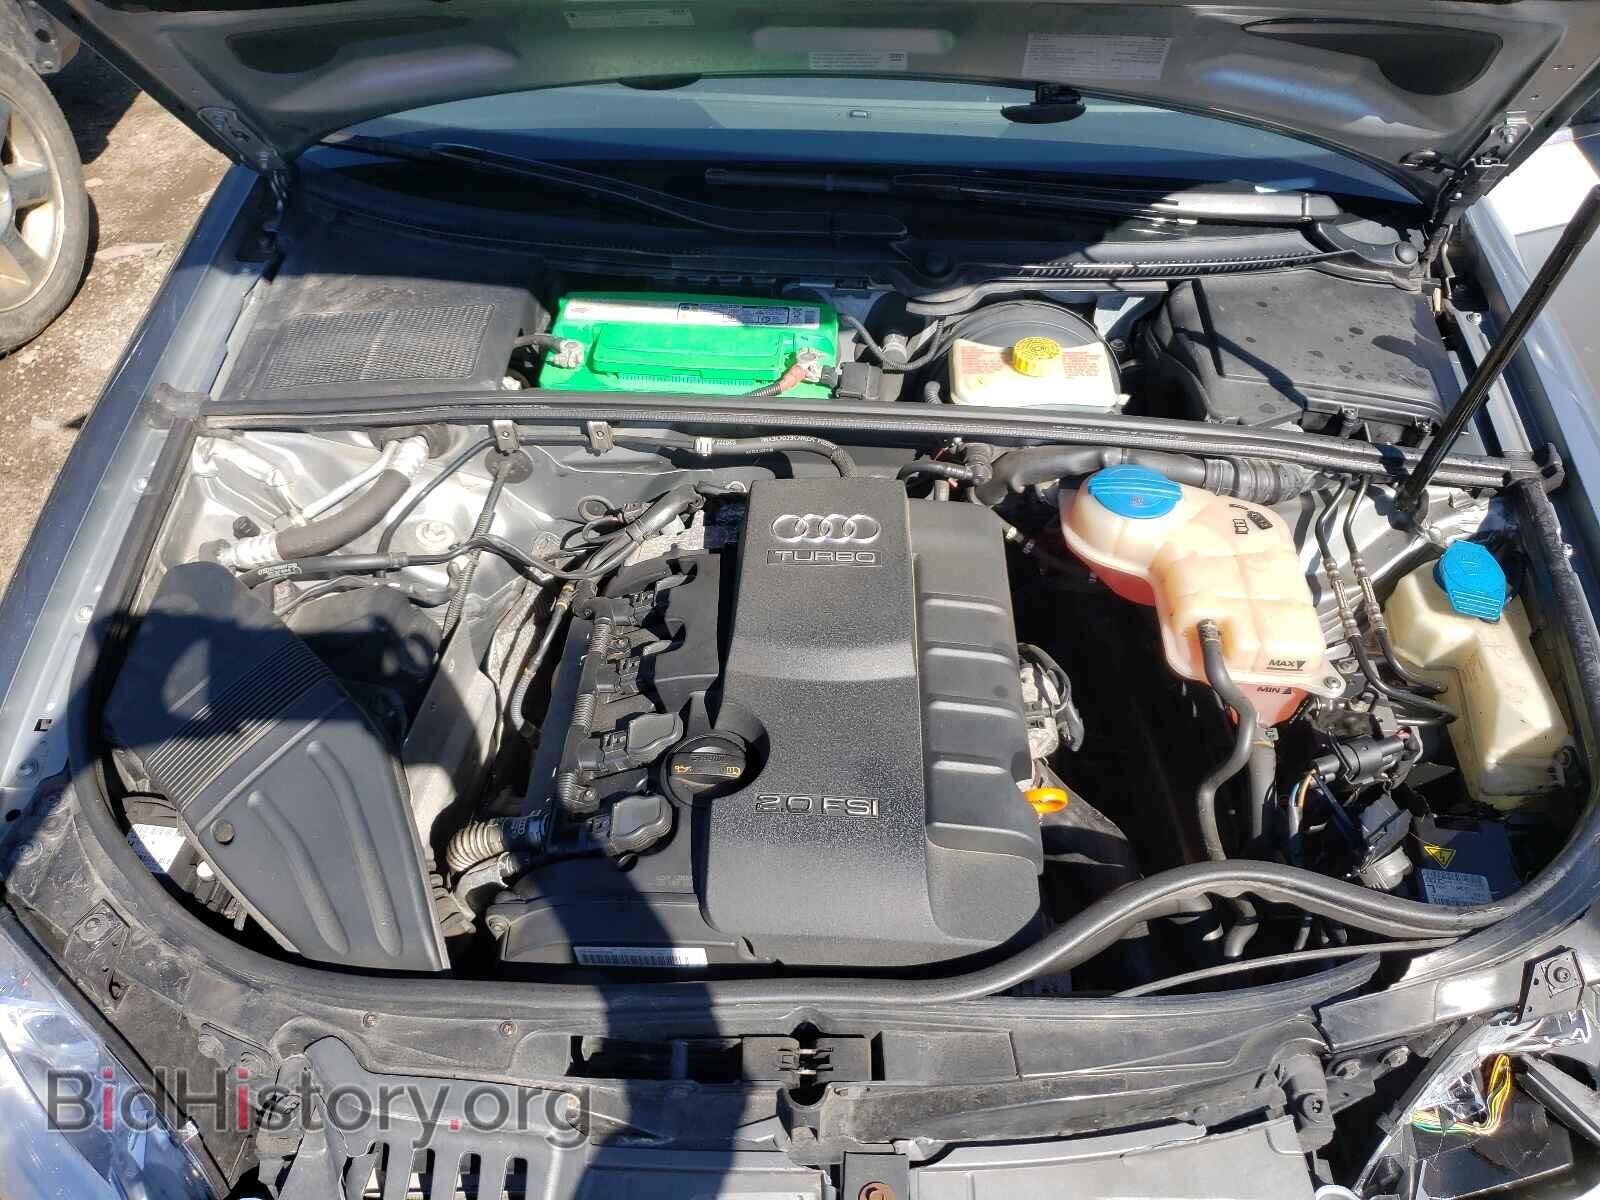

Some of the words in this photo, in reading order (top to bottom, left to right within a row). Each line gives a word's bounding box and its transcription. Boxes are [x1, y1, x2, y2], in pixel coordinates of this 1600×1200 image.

[774, 550, 876, 563] TURBO
[1268, 659, 1296, 667] MAX
[822, 796, 879, 816] FSI
